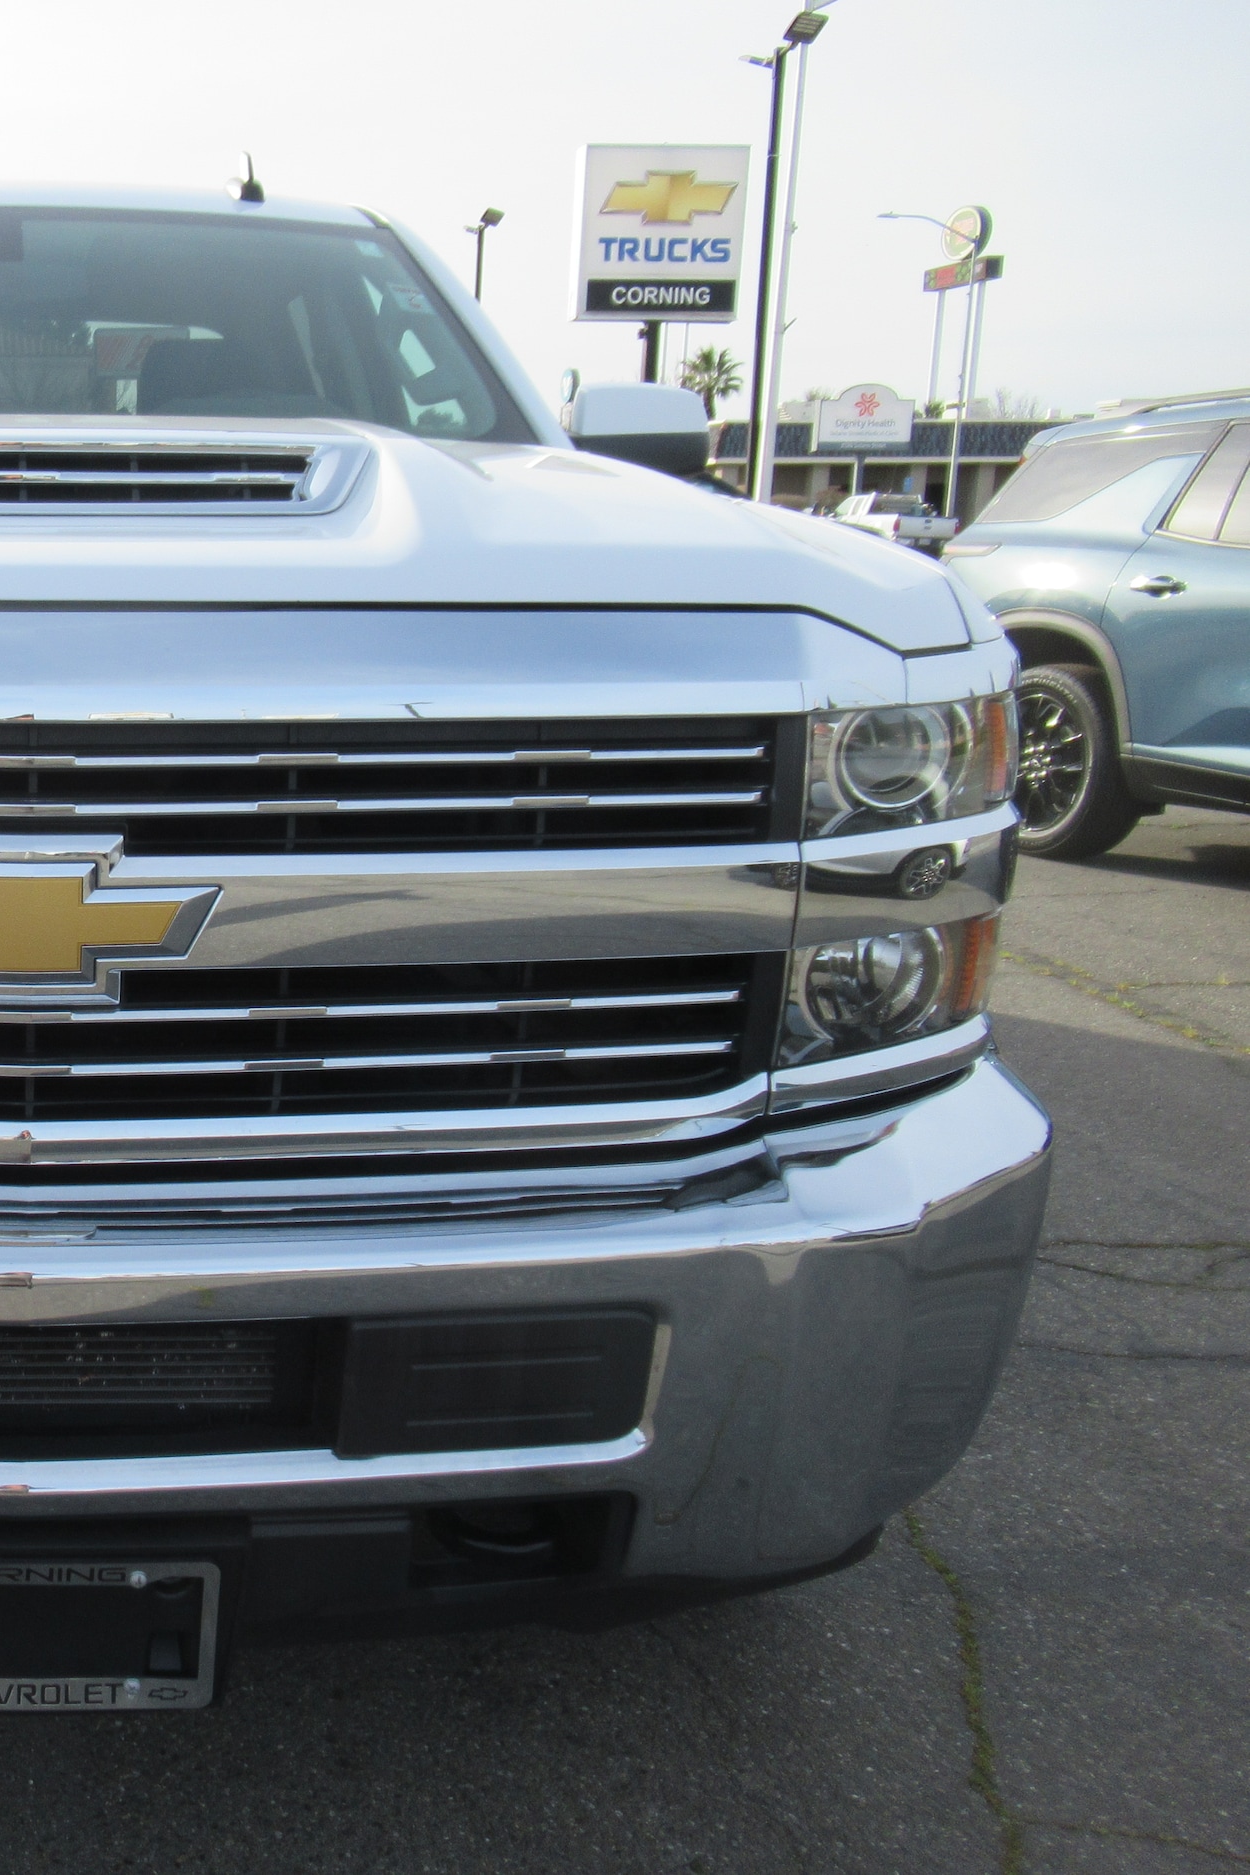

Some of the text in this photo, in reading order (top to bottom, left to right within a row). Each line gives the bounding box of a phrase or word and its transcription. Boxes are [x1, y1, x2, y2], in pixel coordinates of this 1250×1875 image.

[599, 237, 731, 263] TRUCKS
[612, 286, 711, 305] CORNING
[835, 419, 896, 429] Dignity Health
